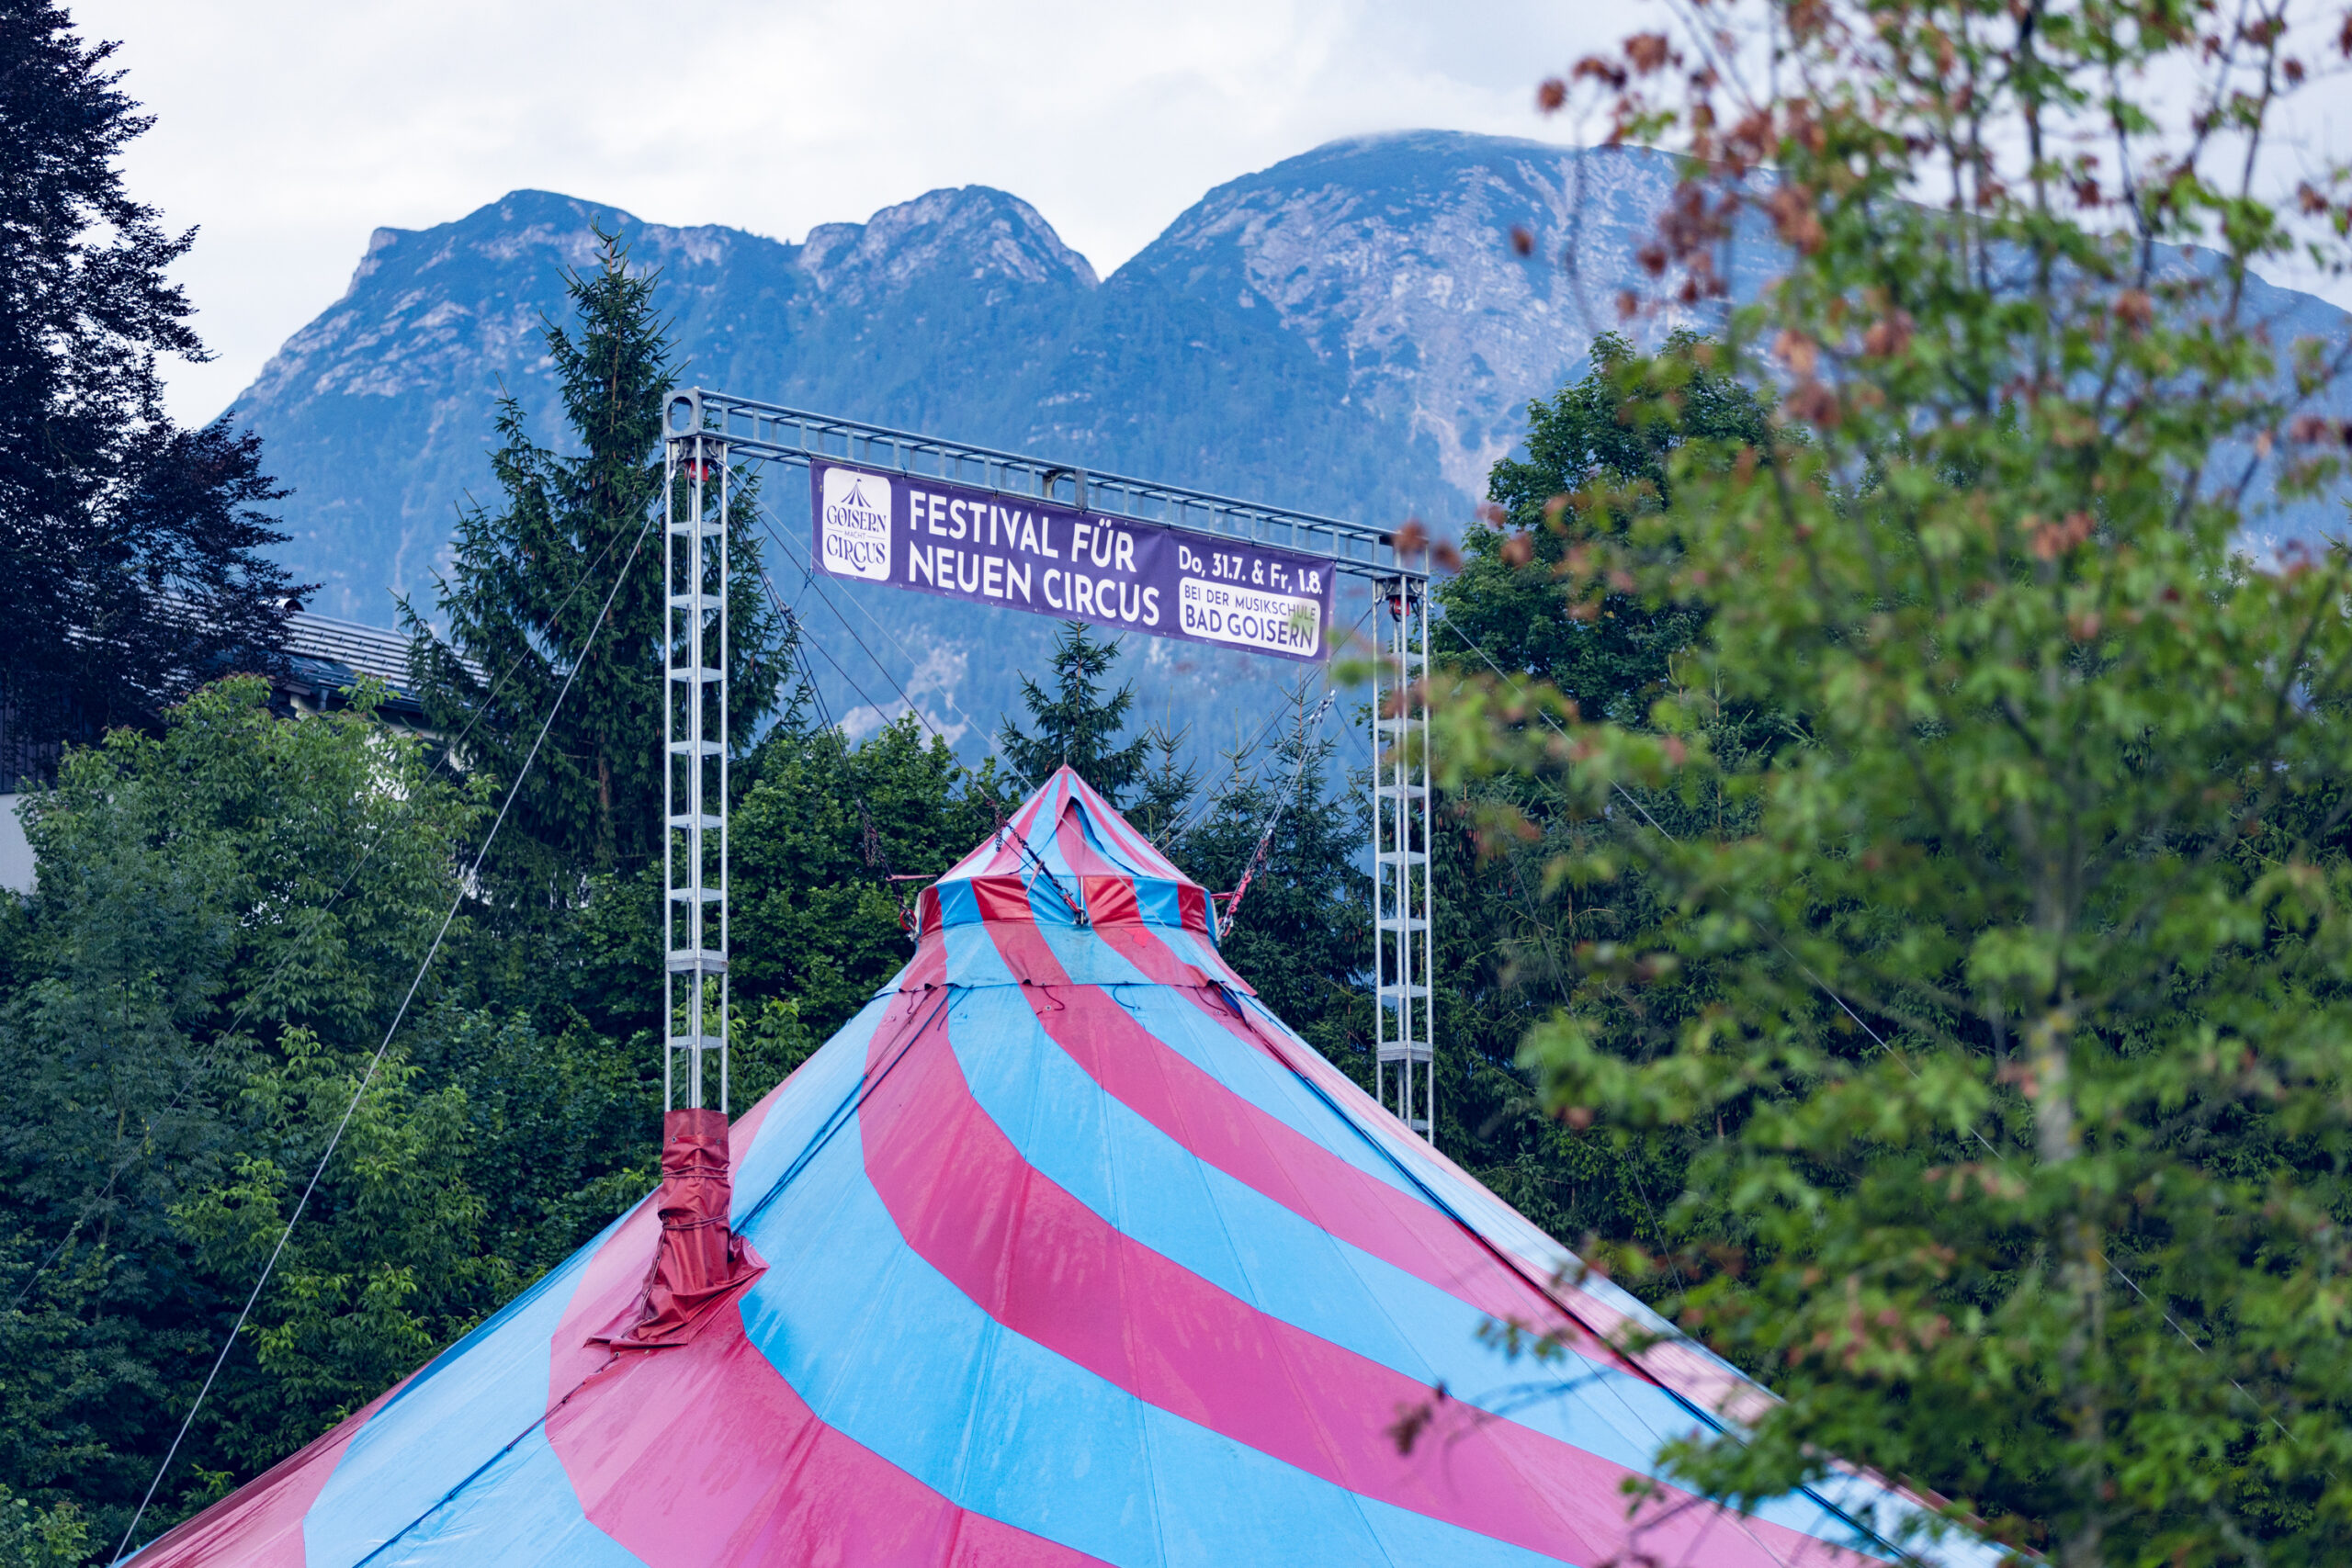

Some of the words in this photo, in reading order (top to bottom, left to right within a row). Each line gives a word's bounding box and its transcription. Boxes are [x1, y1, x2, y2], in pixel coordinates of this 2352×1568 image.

[827, 505, 886, 532] GOISERN
[844, 531, 866, 539] MACHT
[910, 490, 1058, 558] FESTIVAL
[1071, 518, 1136, 572] FÜR
[827, 534, 886, 571] CIRCUS
[1179, 545, 1205, 578] Do,
[1212, 553, 1246, 581] 31.7.
[1251, 559, 1264, 585] &
[1271, 563, 1293, 593] Fr,
[1298, 569, 1323, 594] 1.8.
[909, 540, 1031, 604] NEUEN
[1044, 569, 1159, 626] CIRCUS
[1184, 584, 1201, 601] BEI
[1206, 589, 1229, 606] DER
[1235, 595, 1316, 622] MUSIKSCHULE
[1185, 604, 1222, 633] BAD
[1227, 613, 1314, 649] GOISERN
